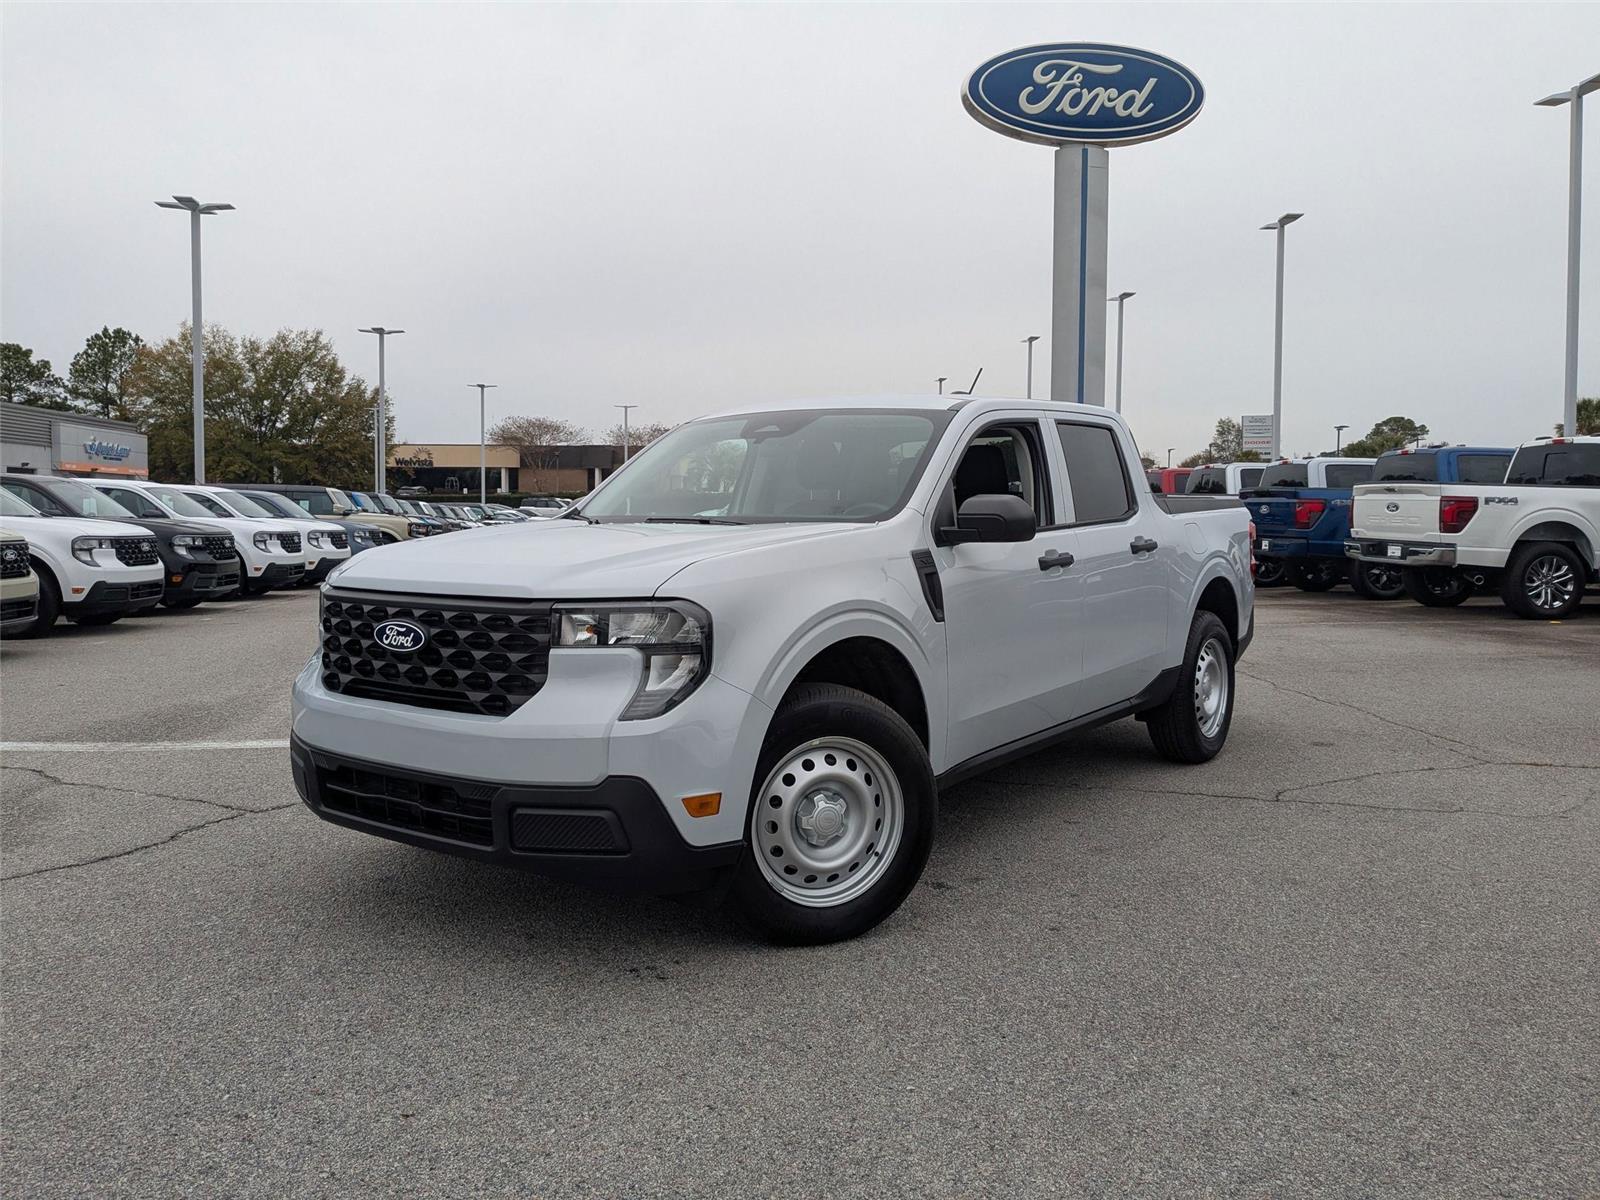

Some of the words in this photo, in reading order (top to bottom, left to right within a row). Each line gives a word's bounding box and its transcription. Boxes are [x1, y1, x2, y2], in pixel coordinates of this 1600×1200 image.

[1018, 59, 1158, 118] Ford
[1484, 496, 1519, 506] FX4
[382, 625, 414, 647] Ford
